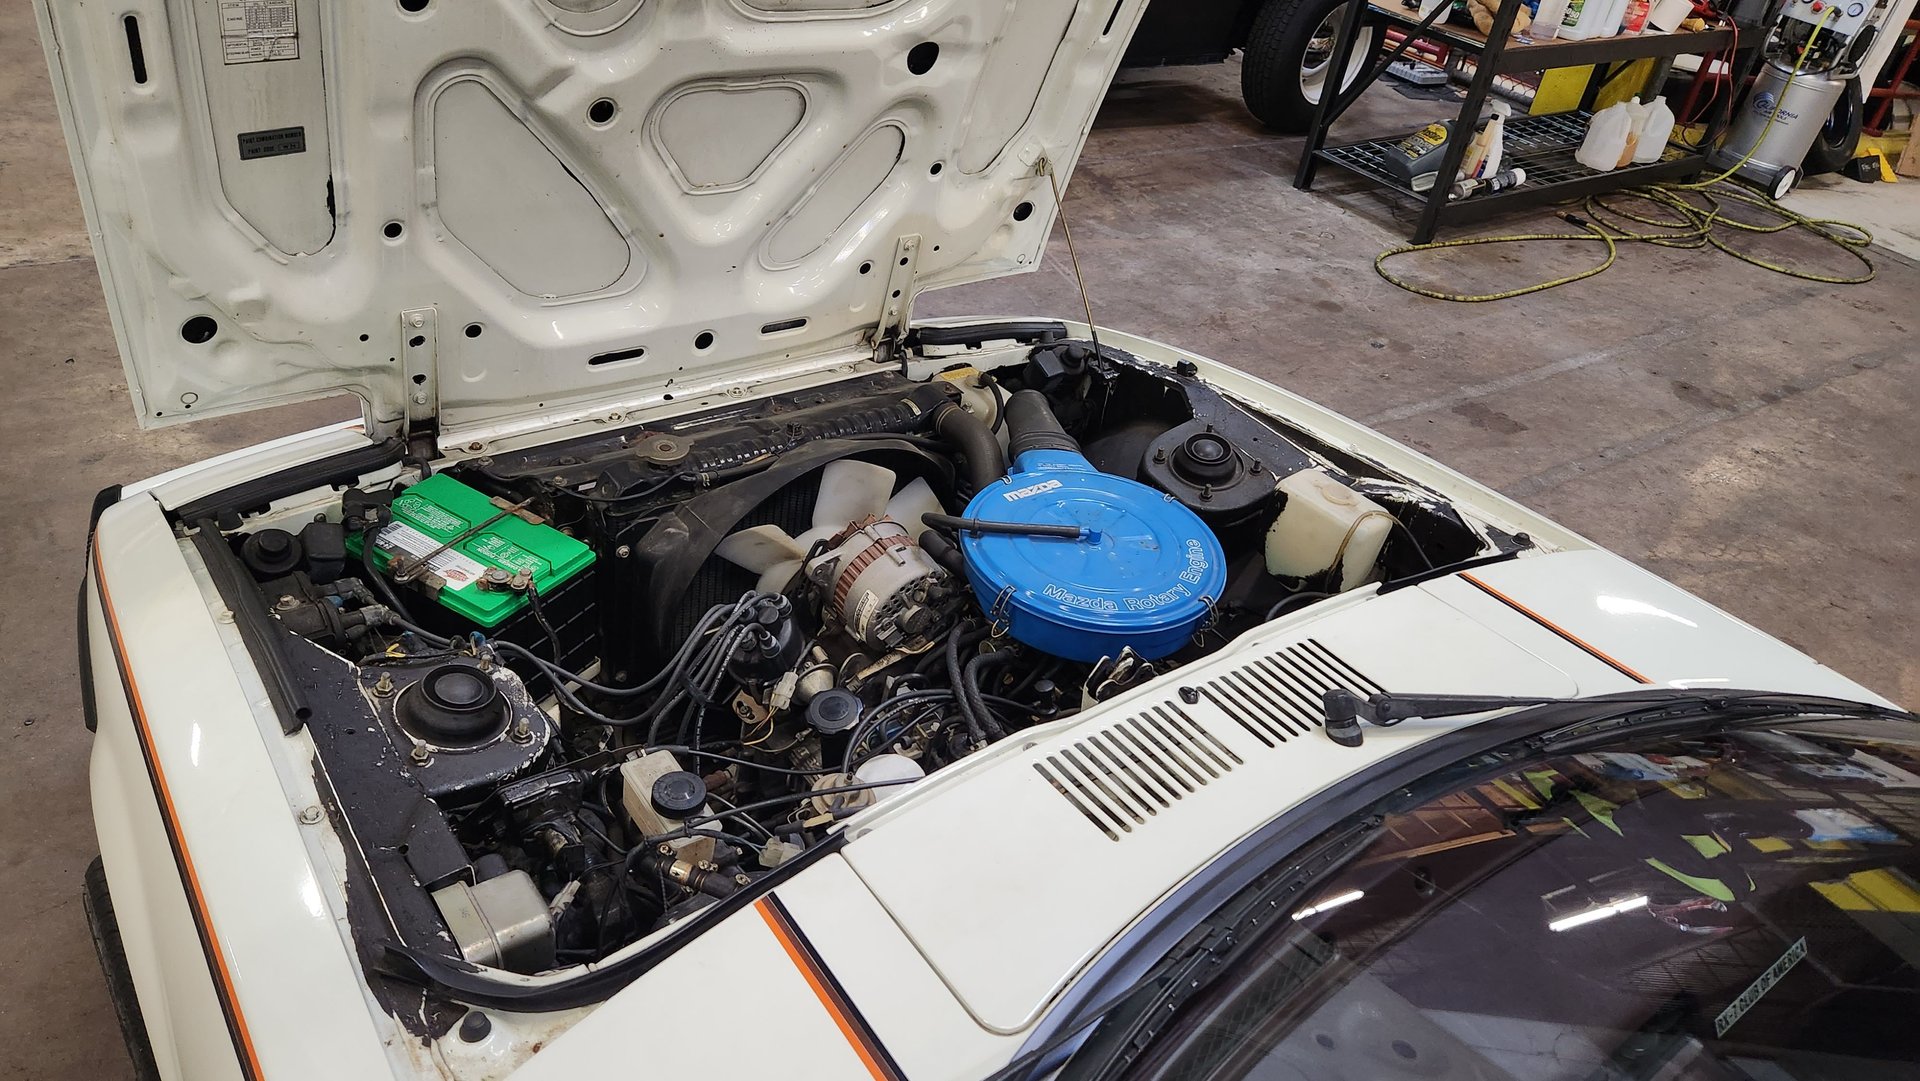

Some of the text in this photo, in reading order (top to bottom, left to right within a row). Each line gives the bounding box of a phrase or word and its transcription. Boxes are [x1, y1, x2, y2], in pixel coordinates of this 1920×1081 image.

[1003, 479, 1063, 502] mazda
[1042, 538, 1209, 611] Mazda Rotary Engine
[1717, 941, 1806, 1032] RX-7 CLUB OF AMERICA
